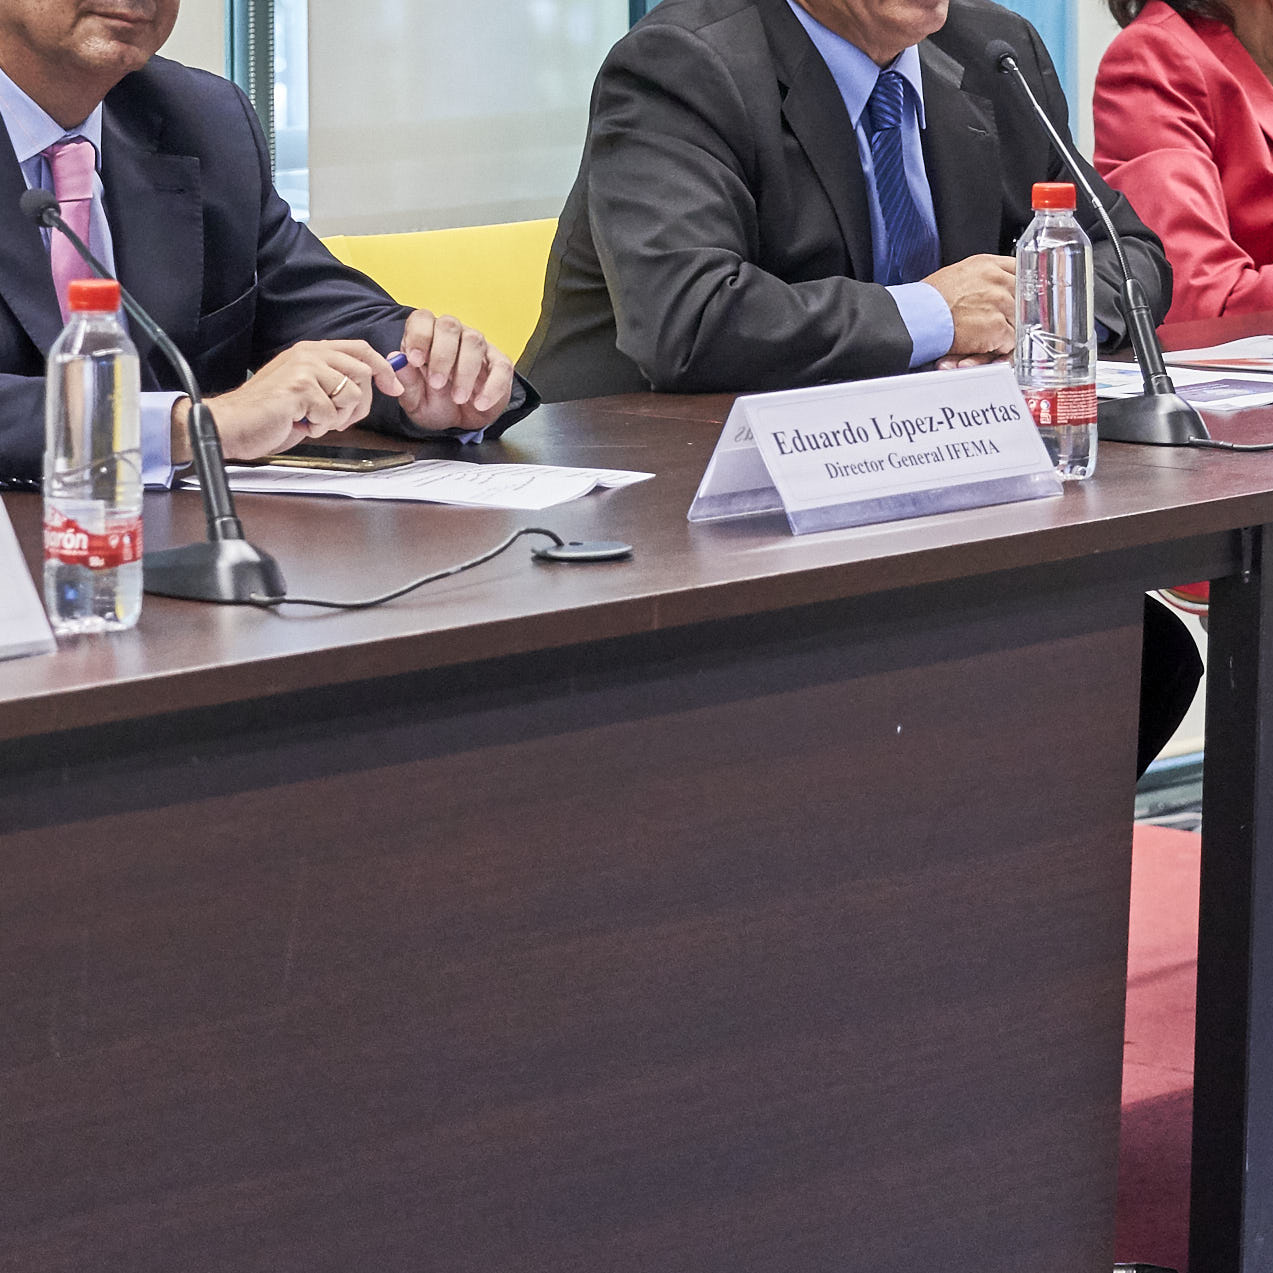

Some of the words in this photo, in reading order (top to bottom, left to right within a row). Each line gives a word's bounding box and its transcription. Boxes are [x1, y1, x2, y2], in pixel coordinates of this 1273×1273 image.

[771, 421, 868, 457] Eduardo
[871, 400, 1022, 445] López-Puertas
[824, 452, 887, 480] Director
[888, 446, 944, 470] General
[946, 439, 1000, 460] IFEMA
